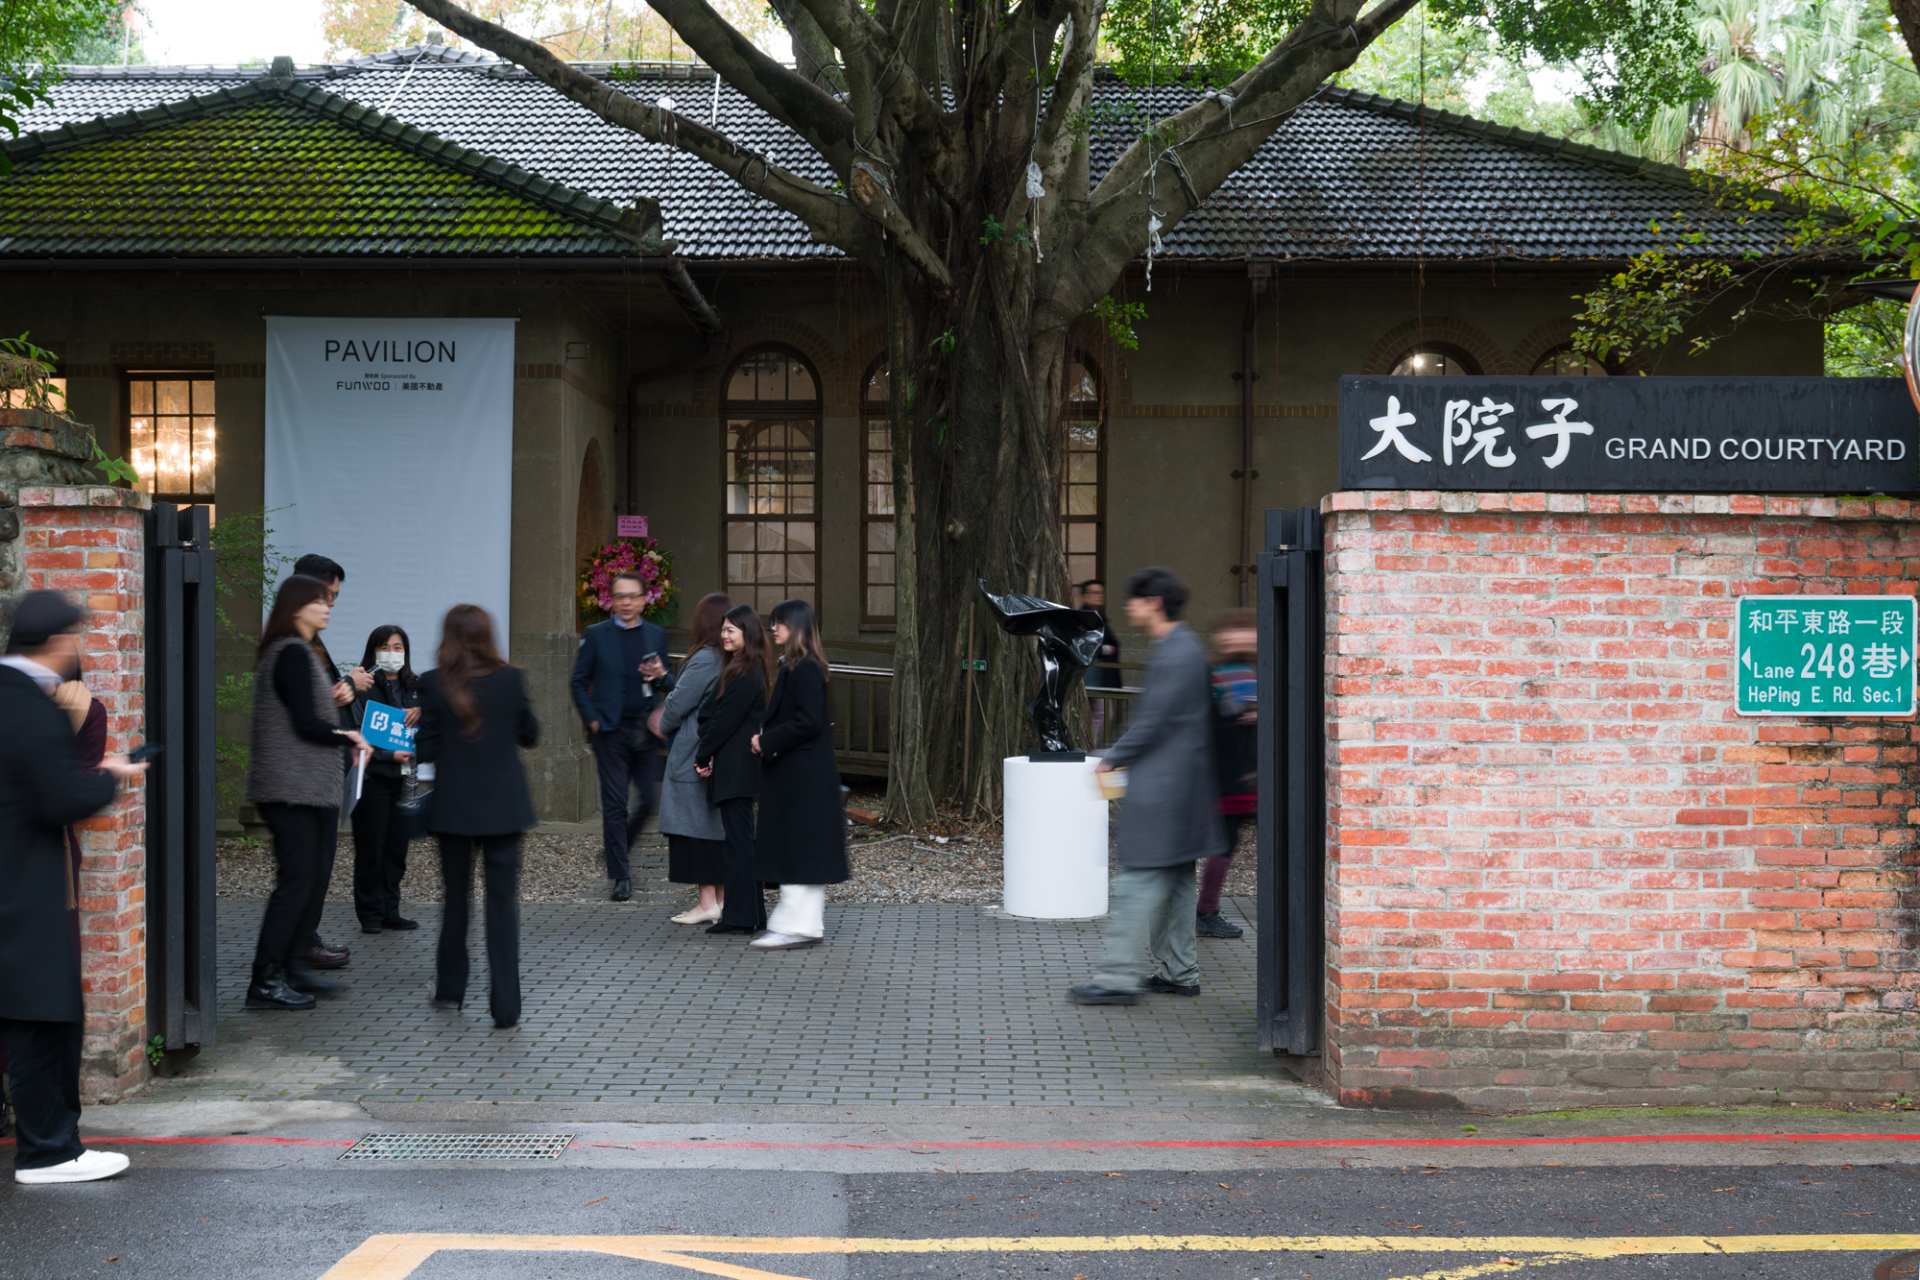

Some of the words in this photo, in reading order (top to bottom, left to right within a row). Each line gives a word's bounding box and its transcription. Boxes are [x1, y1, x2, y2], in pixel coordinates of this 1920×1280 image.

[324, 339, 456, 363] PAVILION
[1360, 395, 1594, 469] 大院子
[1605, 437, 1711, 460] GRAND
[1719, 437, 1906, 461] COURTYARD
[1748, 608, 1905, 635] 和平東路一段
[1753, 661, 1795, 679] Lane
[1748, 686, 1800, 706] HePing
[1811, 686, 1824, 703] E.
[1833, 686, 1855, 703] Rd.
